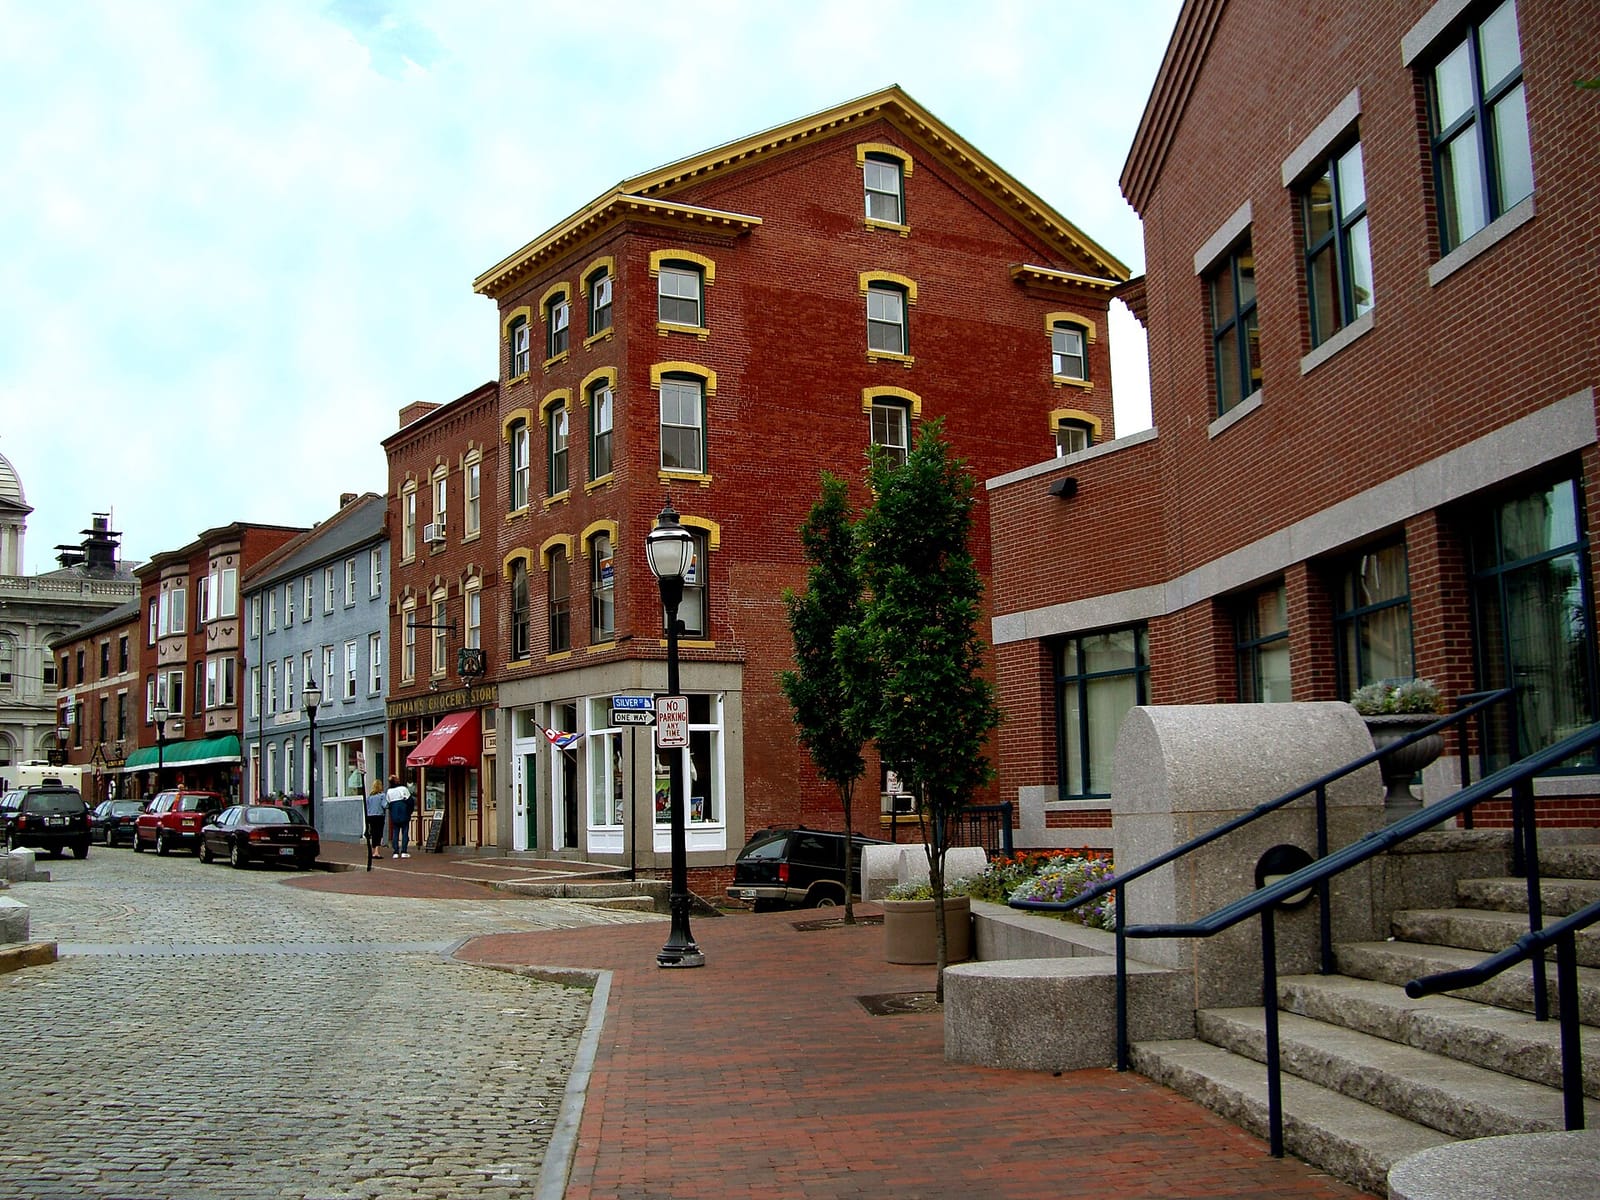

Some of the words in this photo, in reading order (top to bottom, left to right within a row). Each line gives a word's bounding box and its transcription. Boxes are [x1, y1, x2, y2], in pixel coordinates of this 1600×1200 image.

[428, 691, 466, 710] GROCERY
[470, 686, 498, 703] STORE
[615, 698, 638, 707] SILVER
[666, 700, 679, 711] NO
[616, 713, 630, 721] ONE
[633, 713, 648, 721] WAY
[659, 711, 686, 722] PARKING
